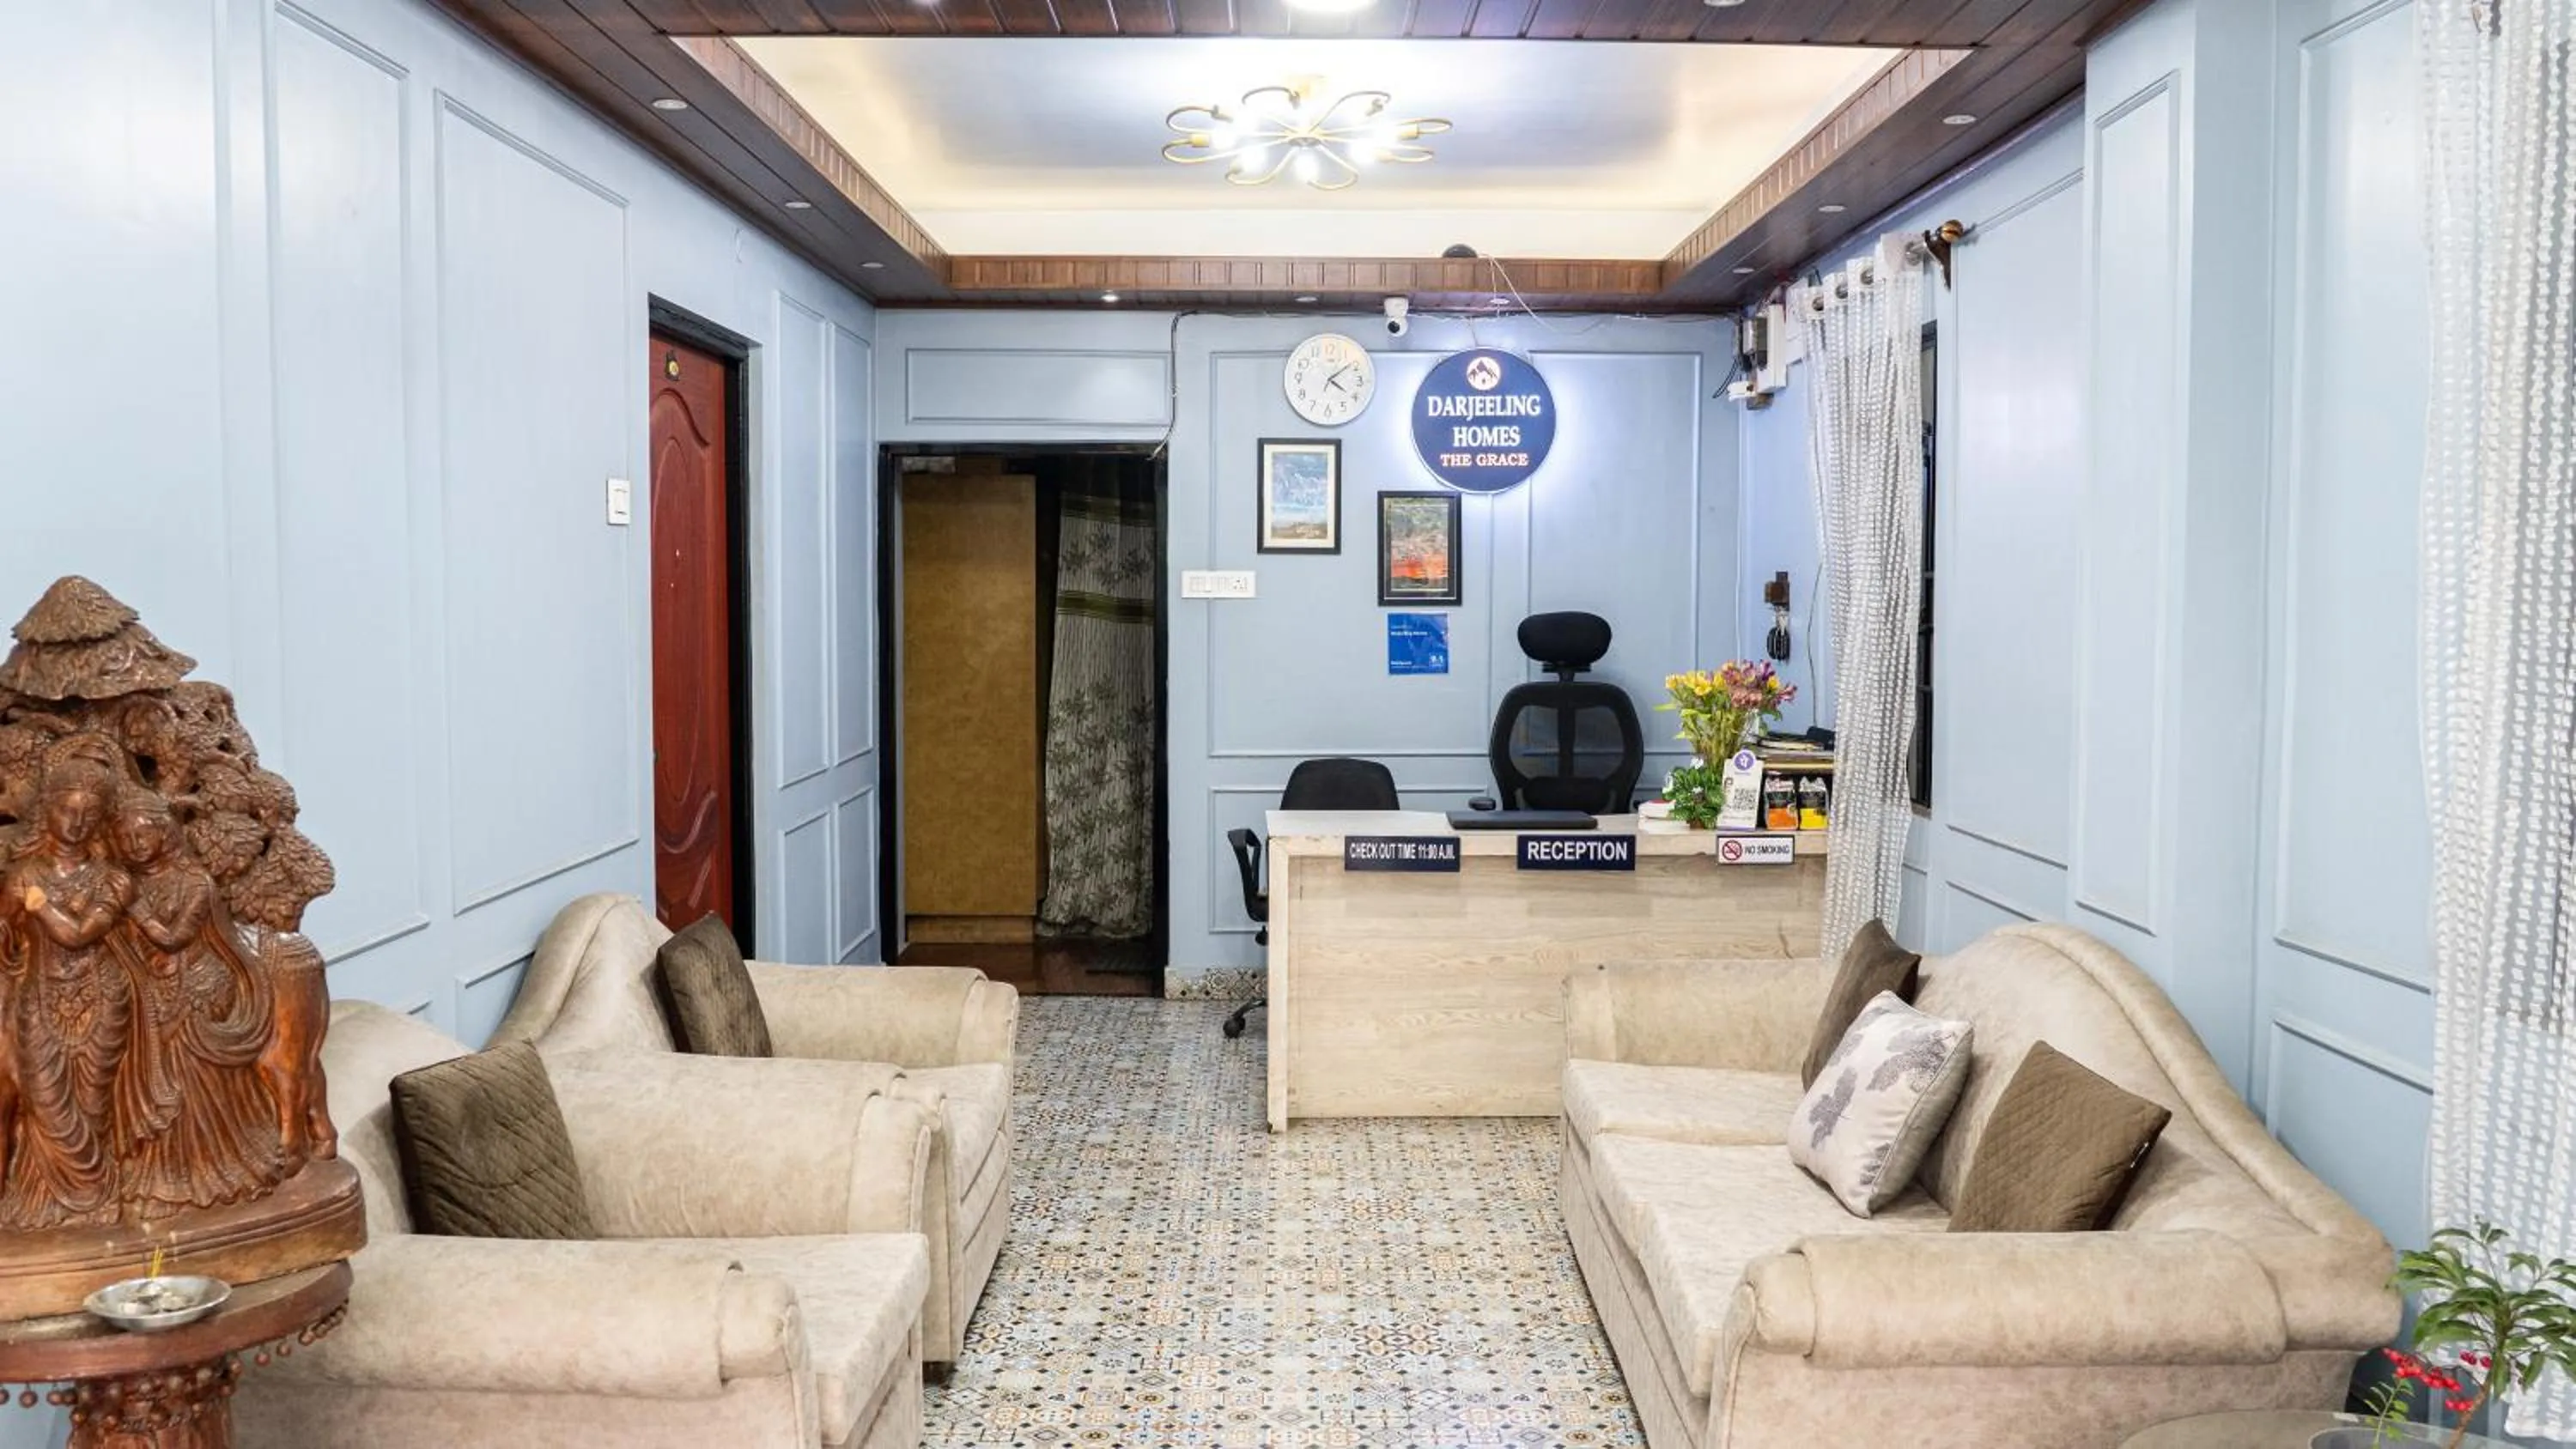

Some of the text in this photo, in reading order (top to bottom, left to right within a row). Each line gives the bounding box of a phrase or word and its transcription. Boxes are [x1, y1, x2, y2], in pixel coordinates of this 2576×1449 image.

[1324, 343, 1335, 355] 12
[1294, 372, 1303, 384] 9
[1357, 375, 1364, 387] 3
[1297, 388, 1306, 400] 8
[1309, 400, 1316, 411] 7
[1323, 403, 1332, 418] 6
[1339, 401, 1347, 412] 5
[1427, 395, 1541, 421] DARJEELING
[1452, 426, 1522, 447] HOMES
[1440, 453, 1530, 466] THE GRACE
[1349, 842, 1378, 858] CHECK
[1378, 842, 1396, 858] OUT
[1397, 843, 1416, 858] TIME
[1528, 840, 1628, 861] RECEPTION
[1745, 845, 1789, 855] NO SMOKING
